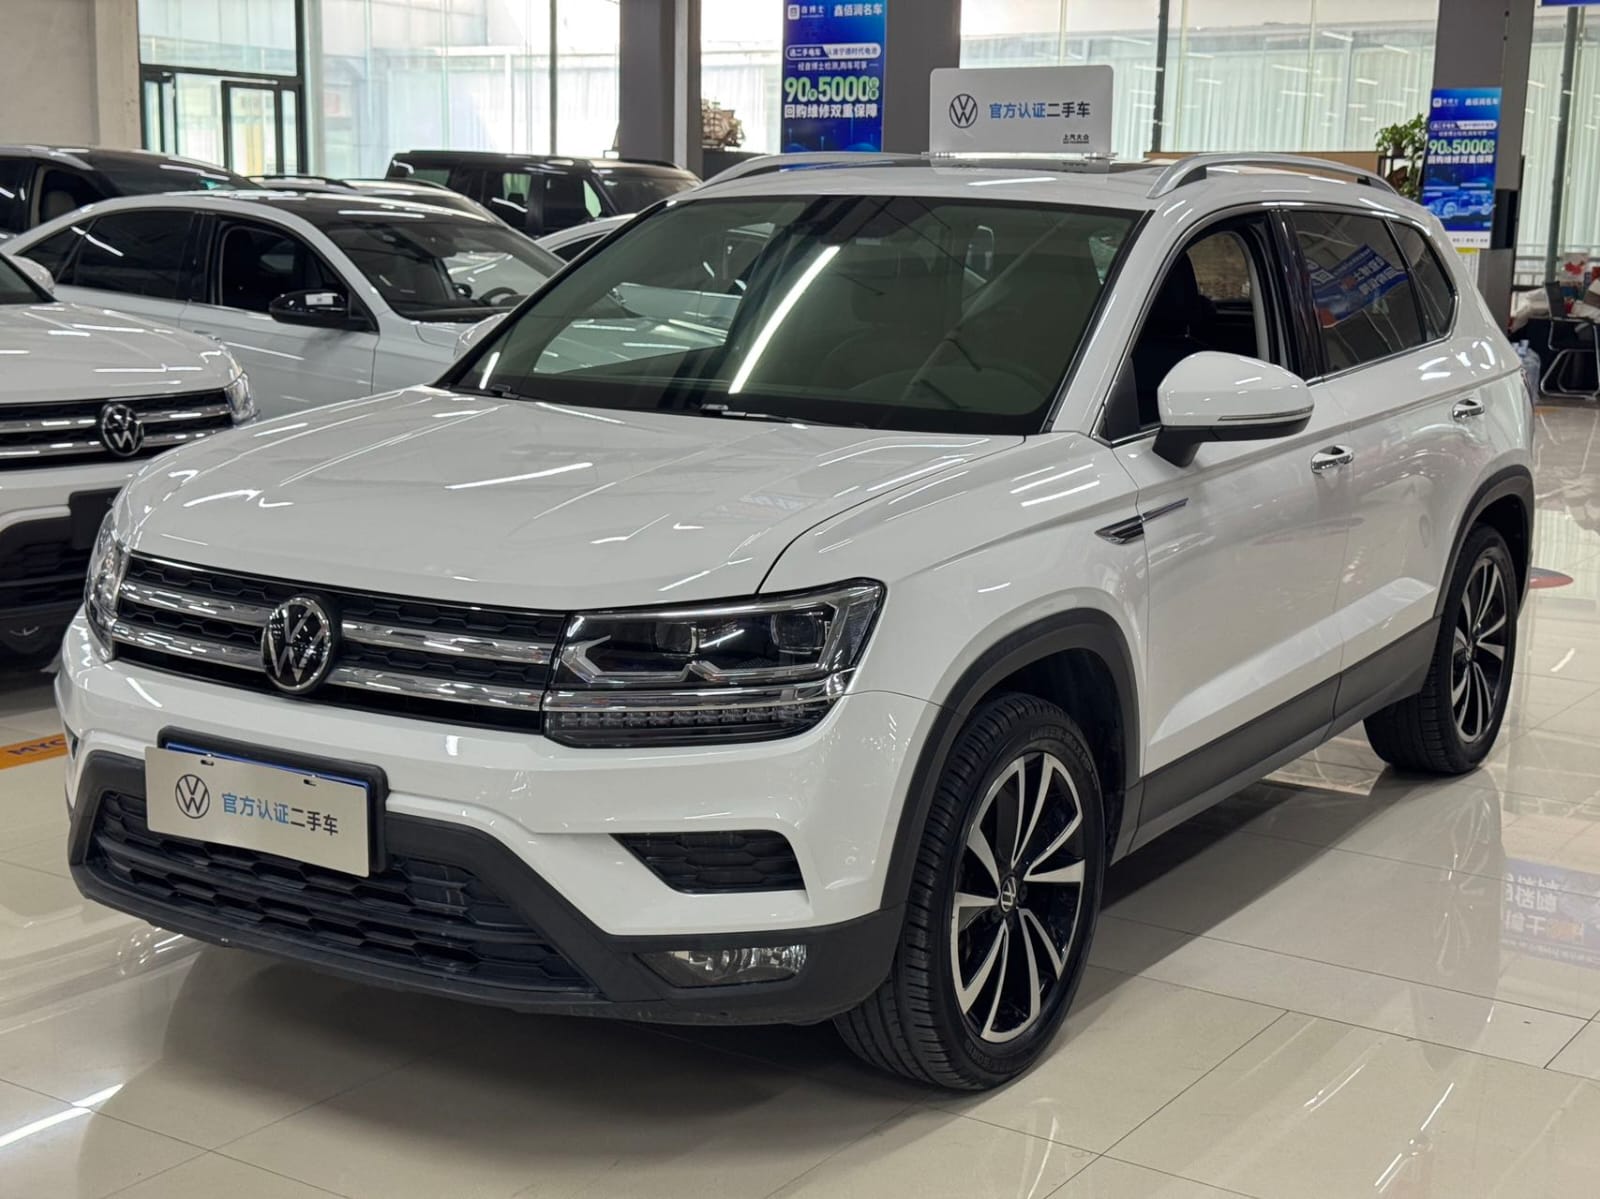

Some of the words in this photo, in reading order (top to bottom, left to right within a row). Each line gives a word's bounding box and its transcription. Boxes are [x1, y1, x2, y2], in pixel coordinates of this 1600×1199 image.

[989, 102, 1091, 119] 官方认证二手车
[221, 792, 339, 836] 官方认证二手车
